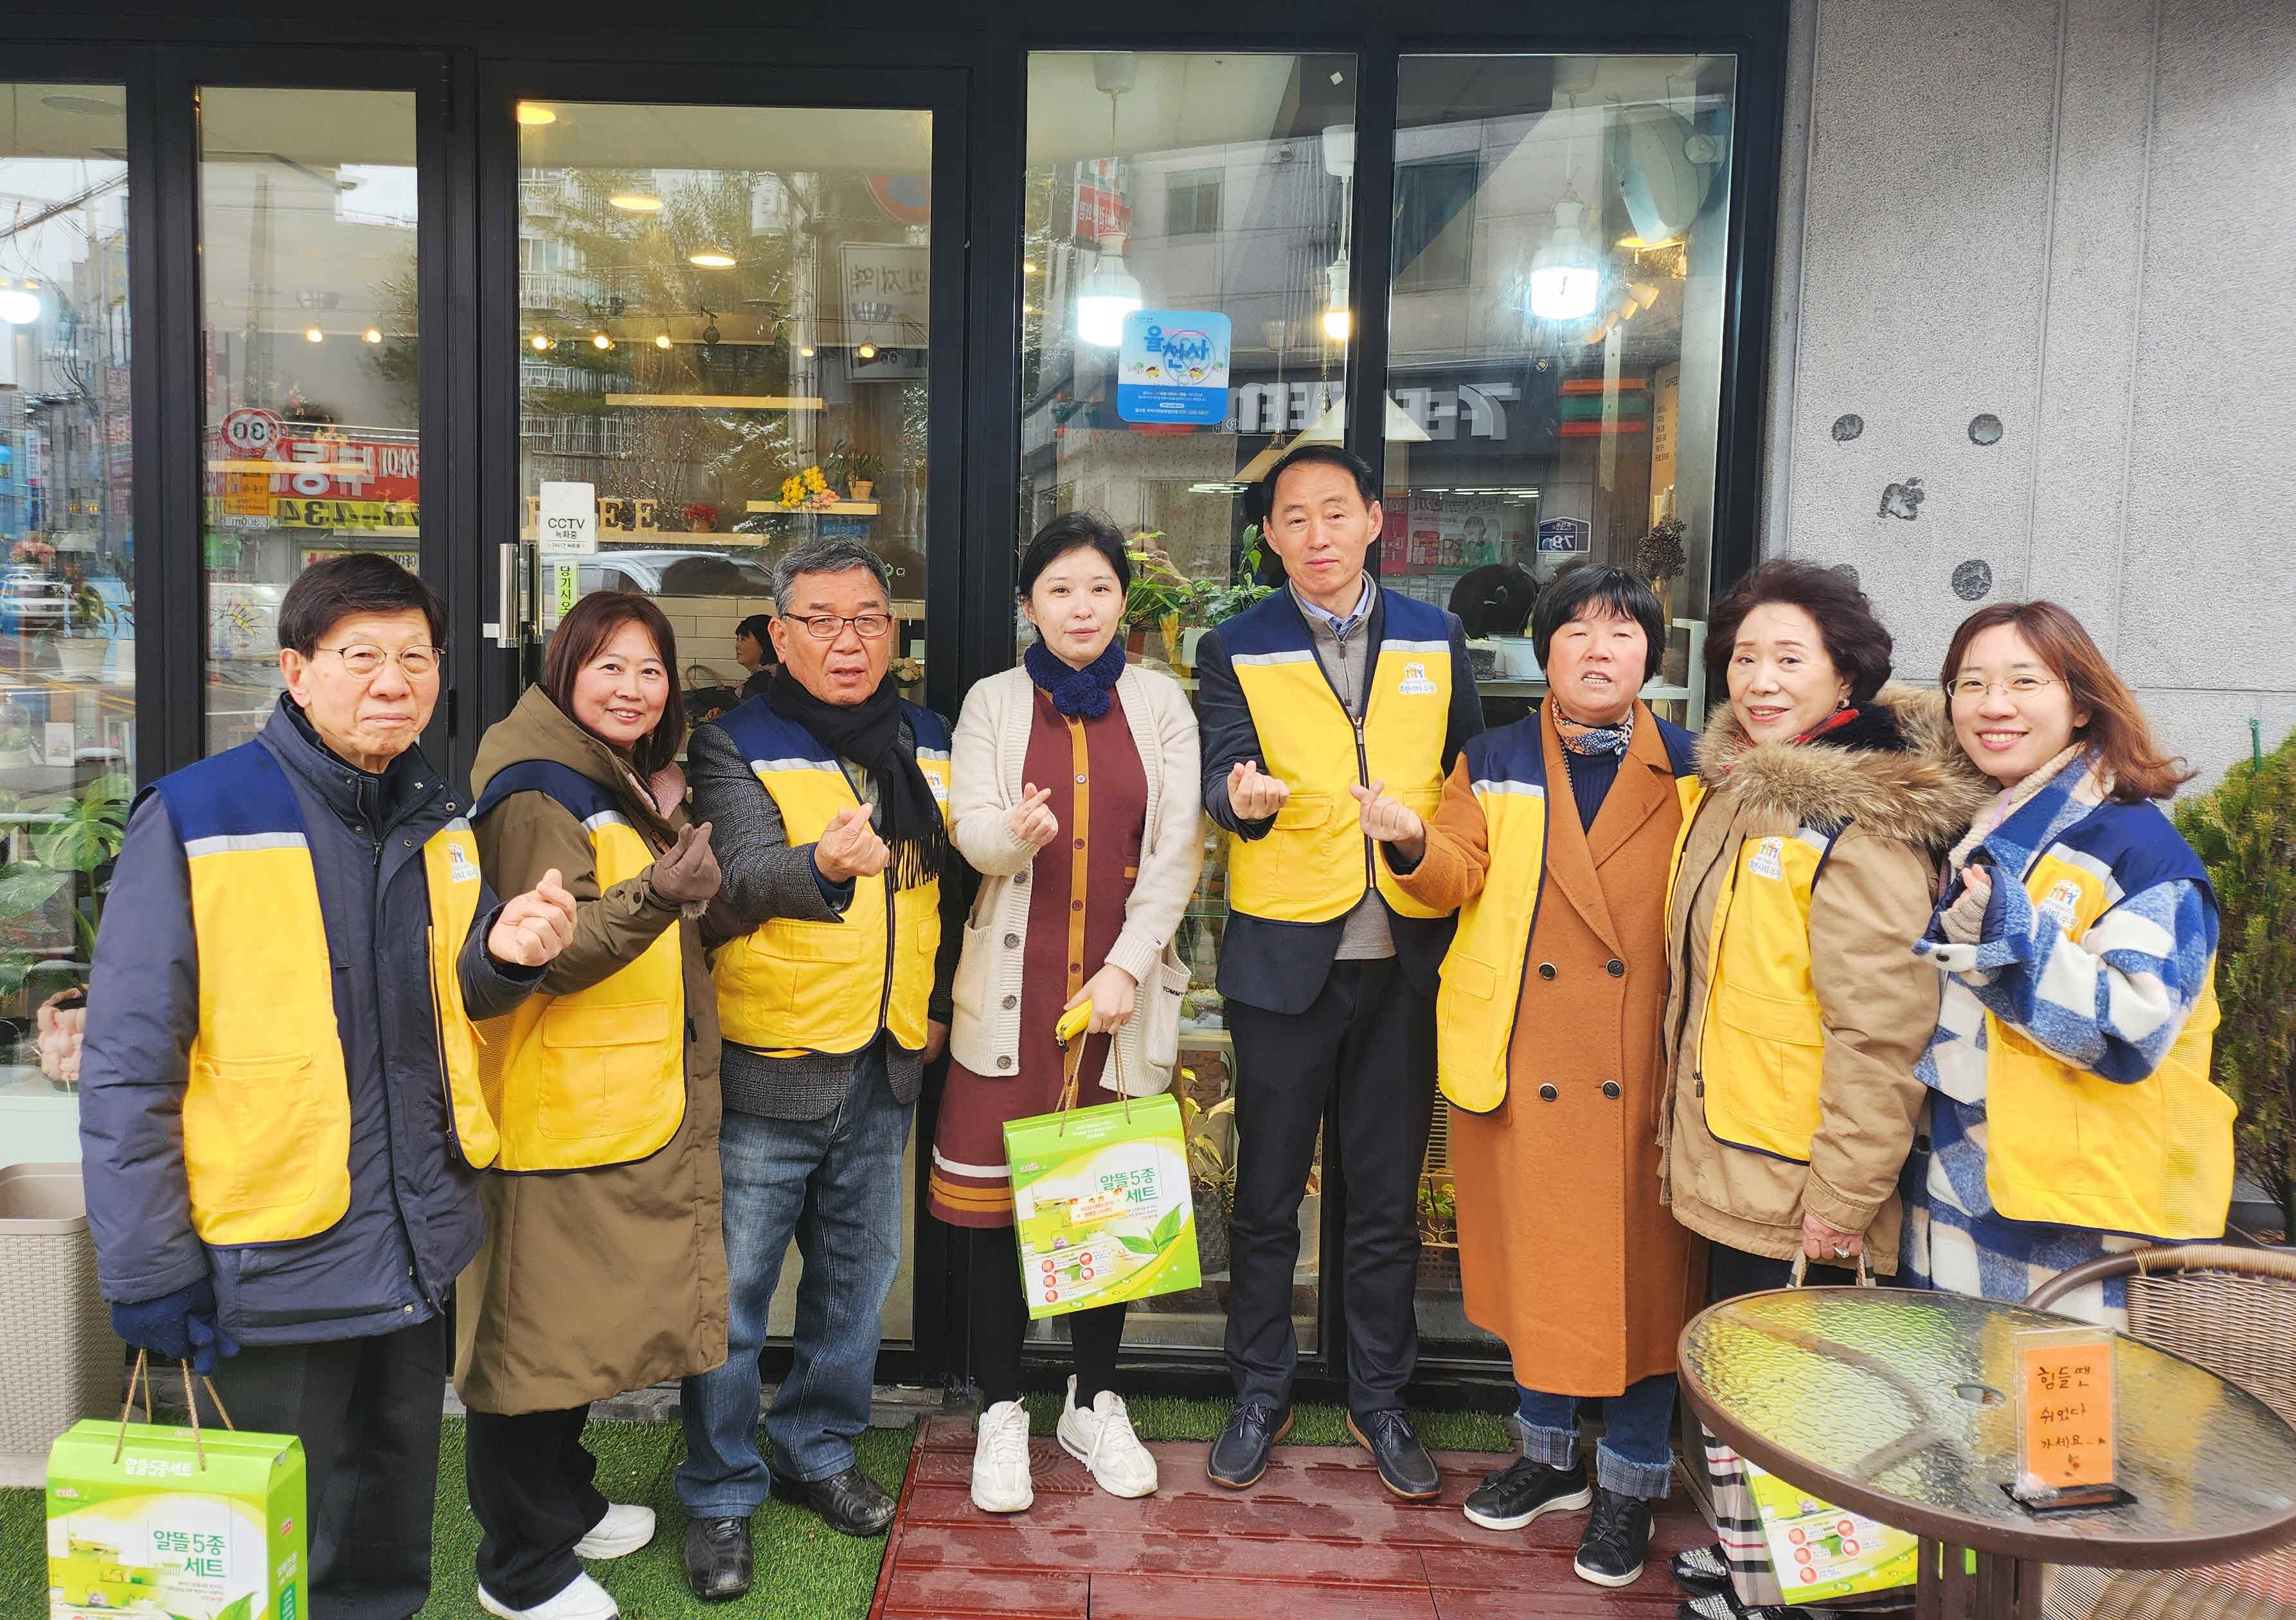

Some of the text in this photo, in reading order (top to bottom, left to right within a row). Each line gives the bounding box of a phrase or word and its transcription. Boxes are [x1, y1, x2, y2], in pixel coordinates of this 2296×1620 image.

[548, 518, 585, 530] CCTV
[555, 530, 577, 540] 녹화중
[559, 565, 571, 611] 당기시오
[1162, 986, 1185, 998] TOMMY
[1126, 1186, 1159, 1204] 세트
[184, 1557, 227, 1578] 세트
